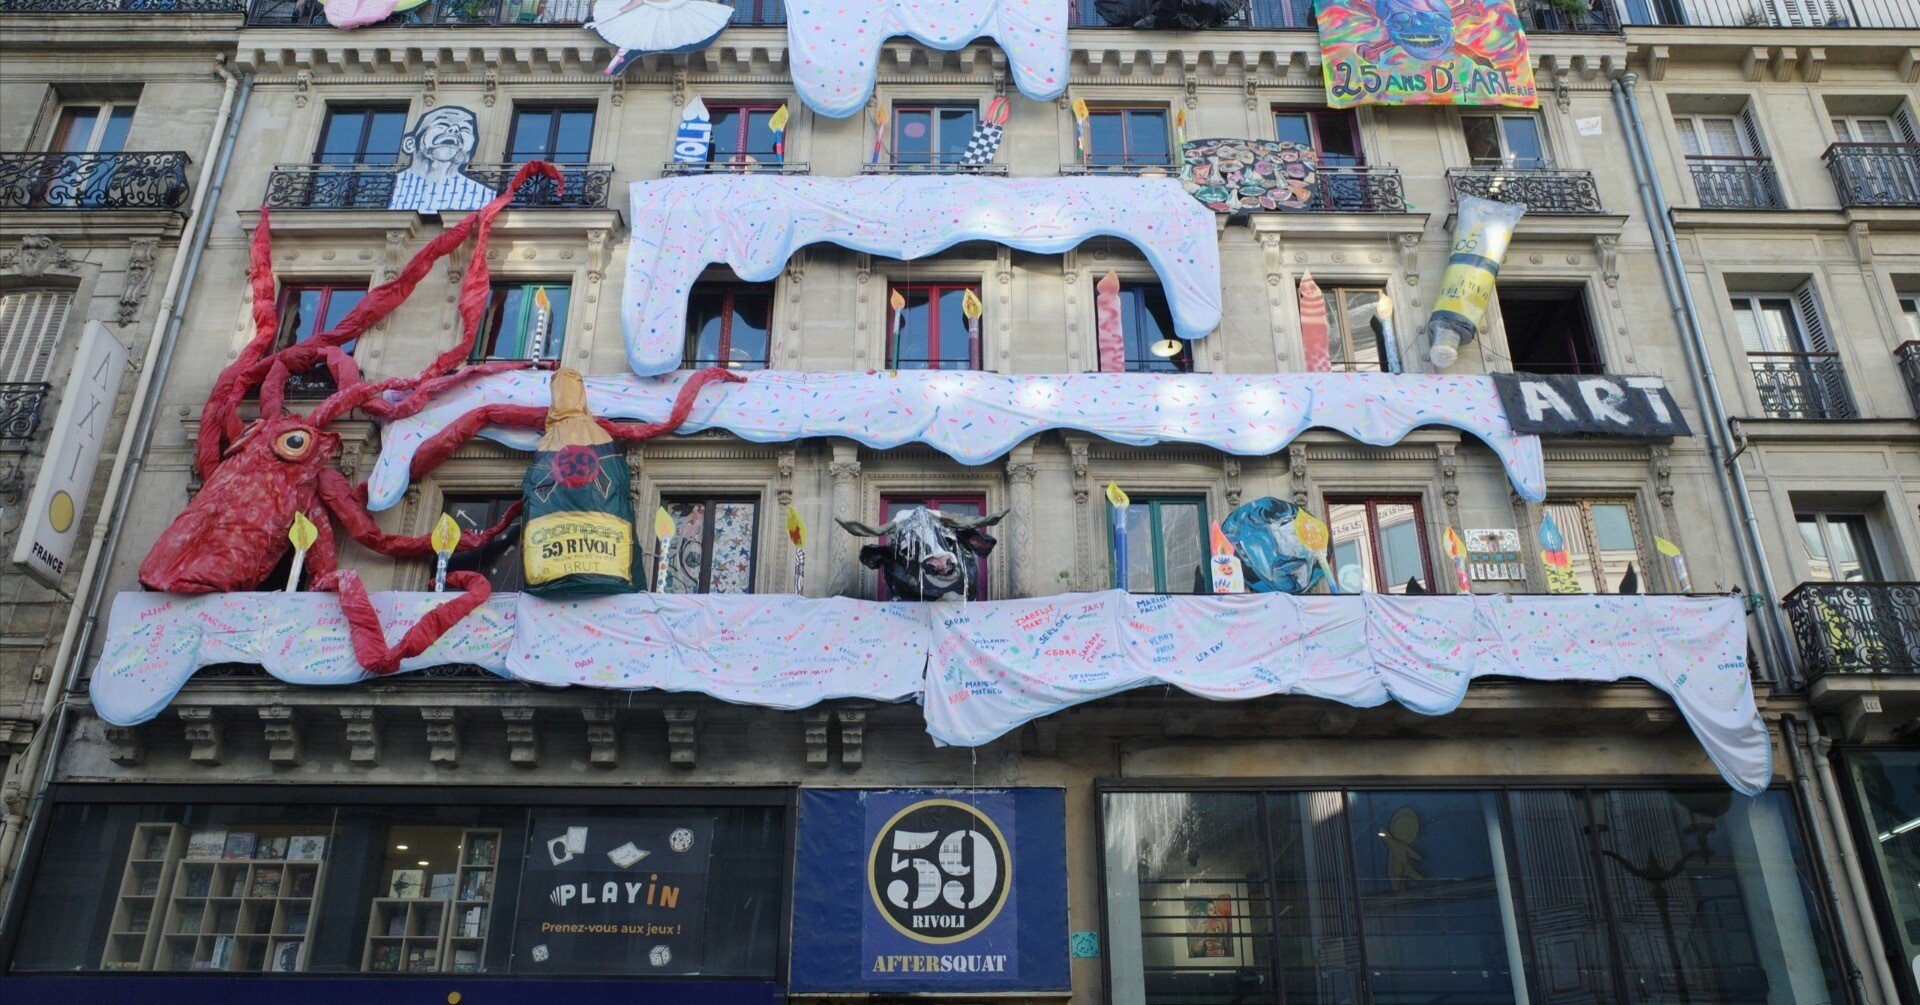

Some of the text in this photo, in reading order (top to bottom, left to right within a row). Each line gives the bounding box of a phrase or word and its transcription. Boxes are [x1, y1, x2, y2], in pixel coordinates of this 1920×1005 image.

[1332, 62, 1382, 97] 25
[1385, 73, 1426, 93] ANS
[1519, 377, 1673, 426] ART
[558, 451, 596, 477] 59
[32, 541, 64, 574] FRANCE
[542, 541, 564, 559] 59
[566, 539, 617, 557] RIVOLI
[563, 561, 601, 573] BRUT
[139, 601, 173, 620] ALINE
[1136, 595, 1173, 608] MARION
[944, 617, 970, 629] SARAH
[1717, 661, 1746, 671] DAVID
[887, 829, 998, 910] 59
[541, 922, 618, 934] Prenez-vous
[621, 924, 644, 934] aux
[646, 923, 674, 936] jeux
[912, 914, 966, 928] RIVOLI
[872, 954, 1007, 973] AFTERSQUAT
